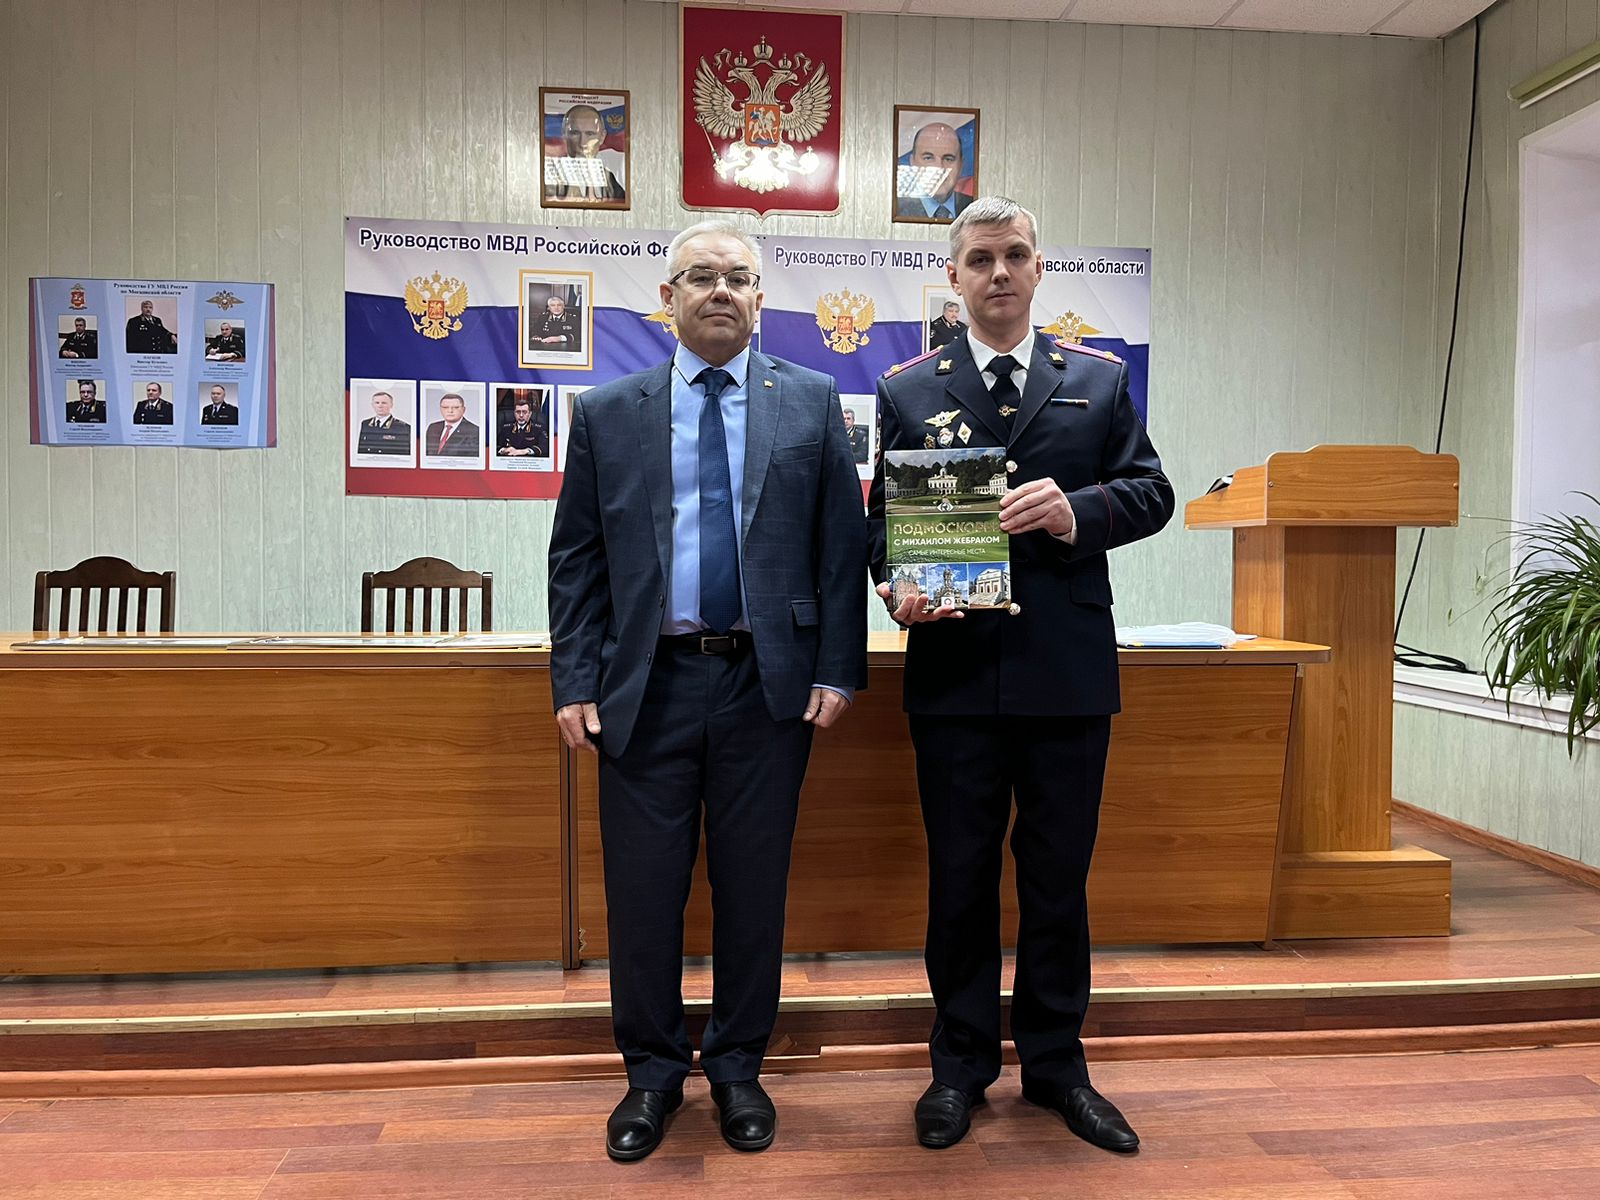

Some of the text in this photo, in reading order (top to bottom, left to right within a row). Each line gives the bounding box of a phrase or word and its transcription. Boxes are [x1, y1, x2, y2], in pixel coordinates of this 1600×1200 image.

[360, 229, 481, 250] Руководство
[487, 234, 529, 255] МВД
[534, 236, 641, 256] Российской
[775, 247, 867, 267] Руководство
[871, 250, 888, 267] ГУ
[891, 251, 923, 271] МВД
[1042, 257, 1144, 274] вской области
[902, 537, 952, 546] МИХАИЛОМ
[953, 535, 1000, 545] ЖЕБРАКОМ
